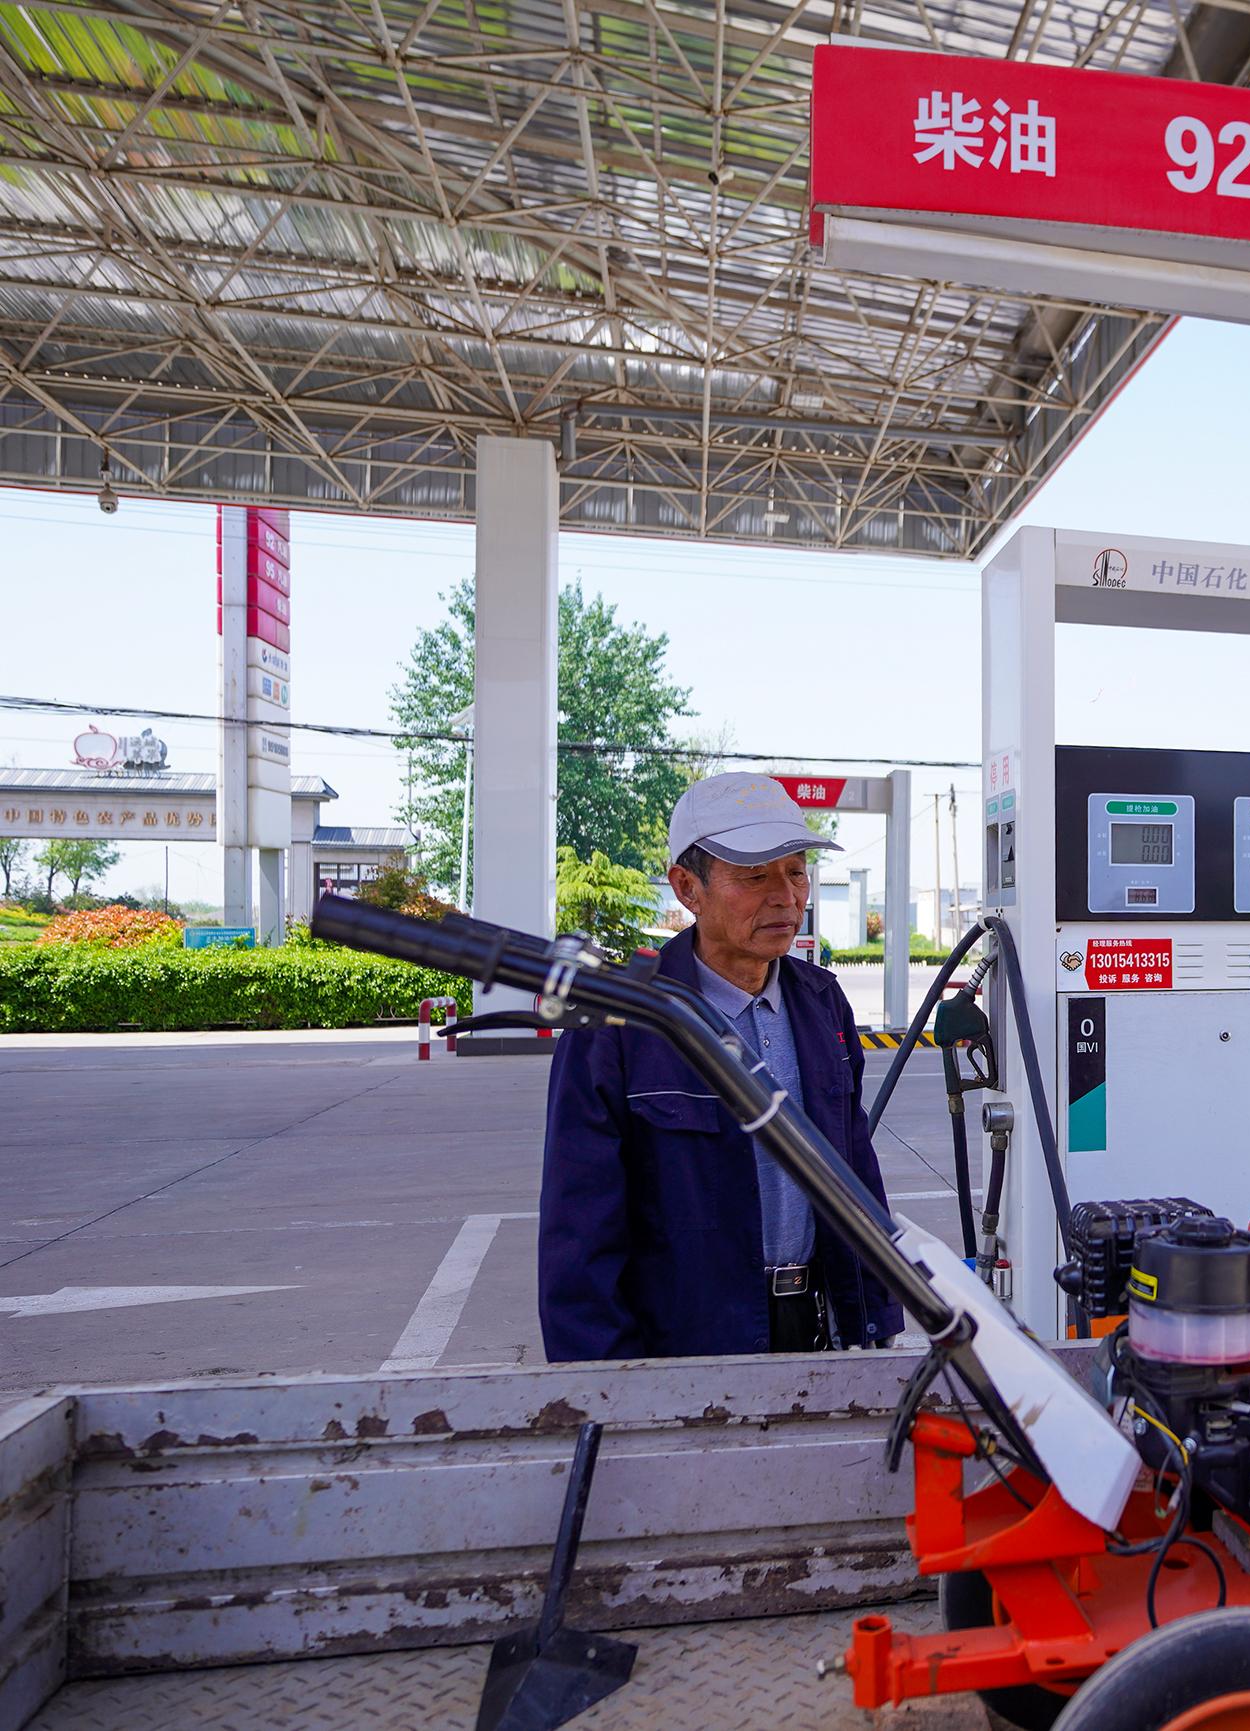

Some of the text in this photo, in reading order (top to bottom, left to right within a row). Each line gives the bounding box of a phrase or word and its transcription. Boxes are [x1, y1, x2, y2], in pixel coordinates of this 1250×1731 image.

[913, 91, 1057, 178] 柴油
[1151, 560, 1248, 591] 中国石化
[797, 784, 826, 800] 柴油
[1090, 953, 1170, 968] 13015413315
[1099, 973, 1162, 984] 投诉 服务 咨询
[1080, 1018, 1094, 1037] 0
